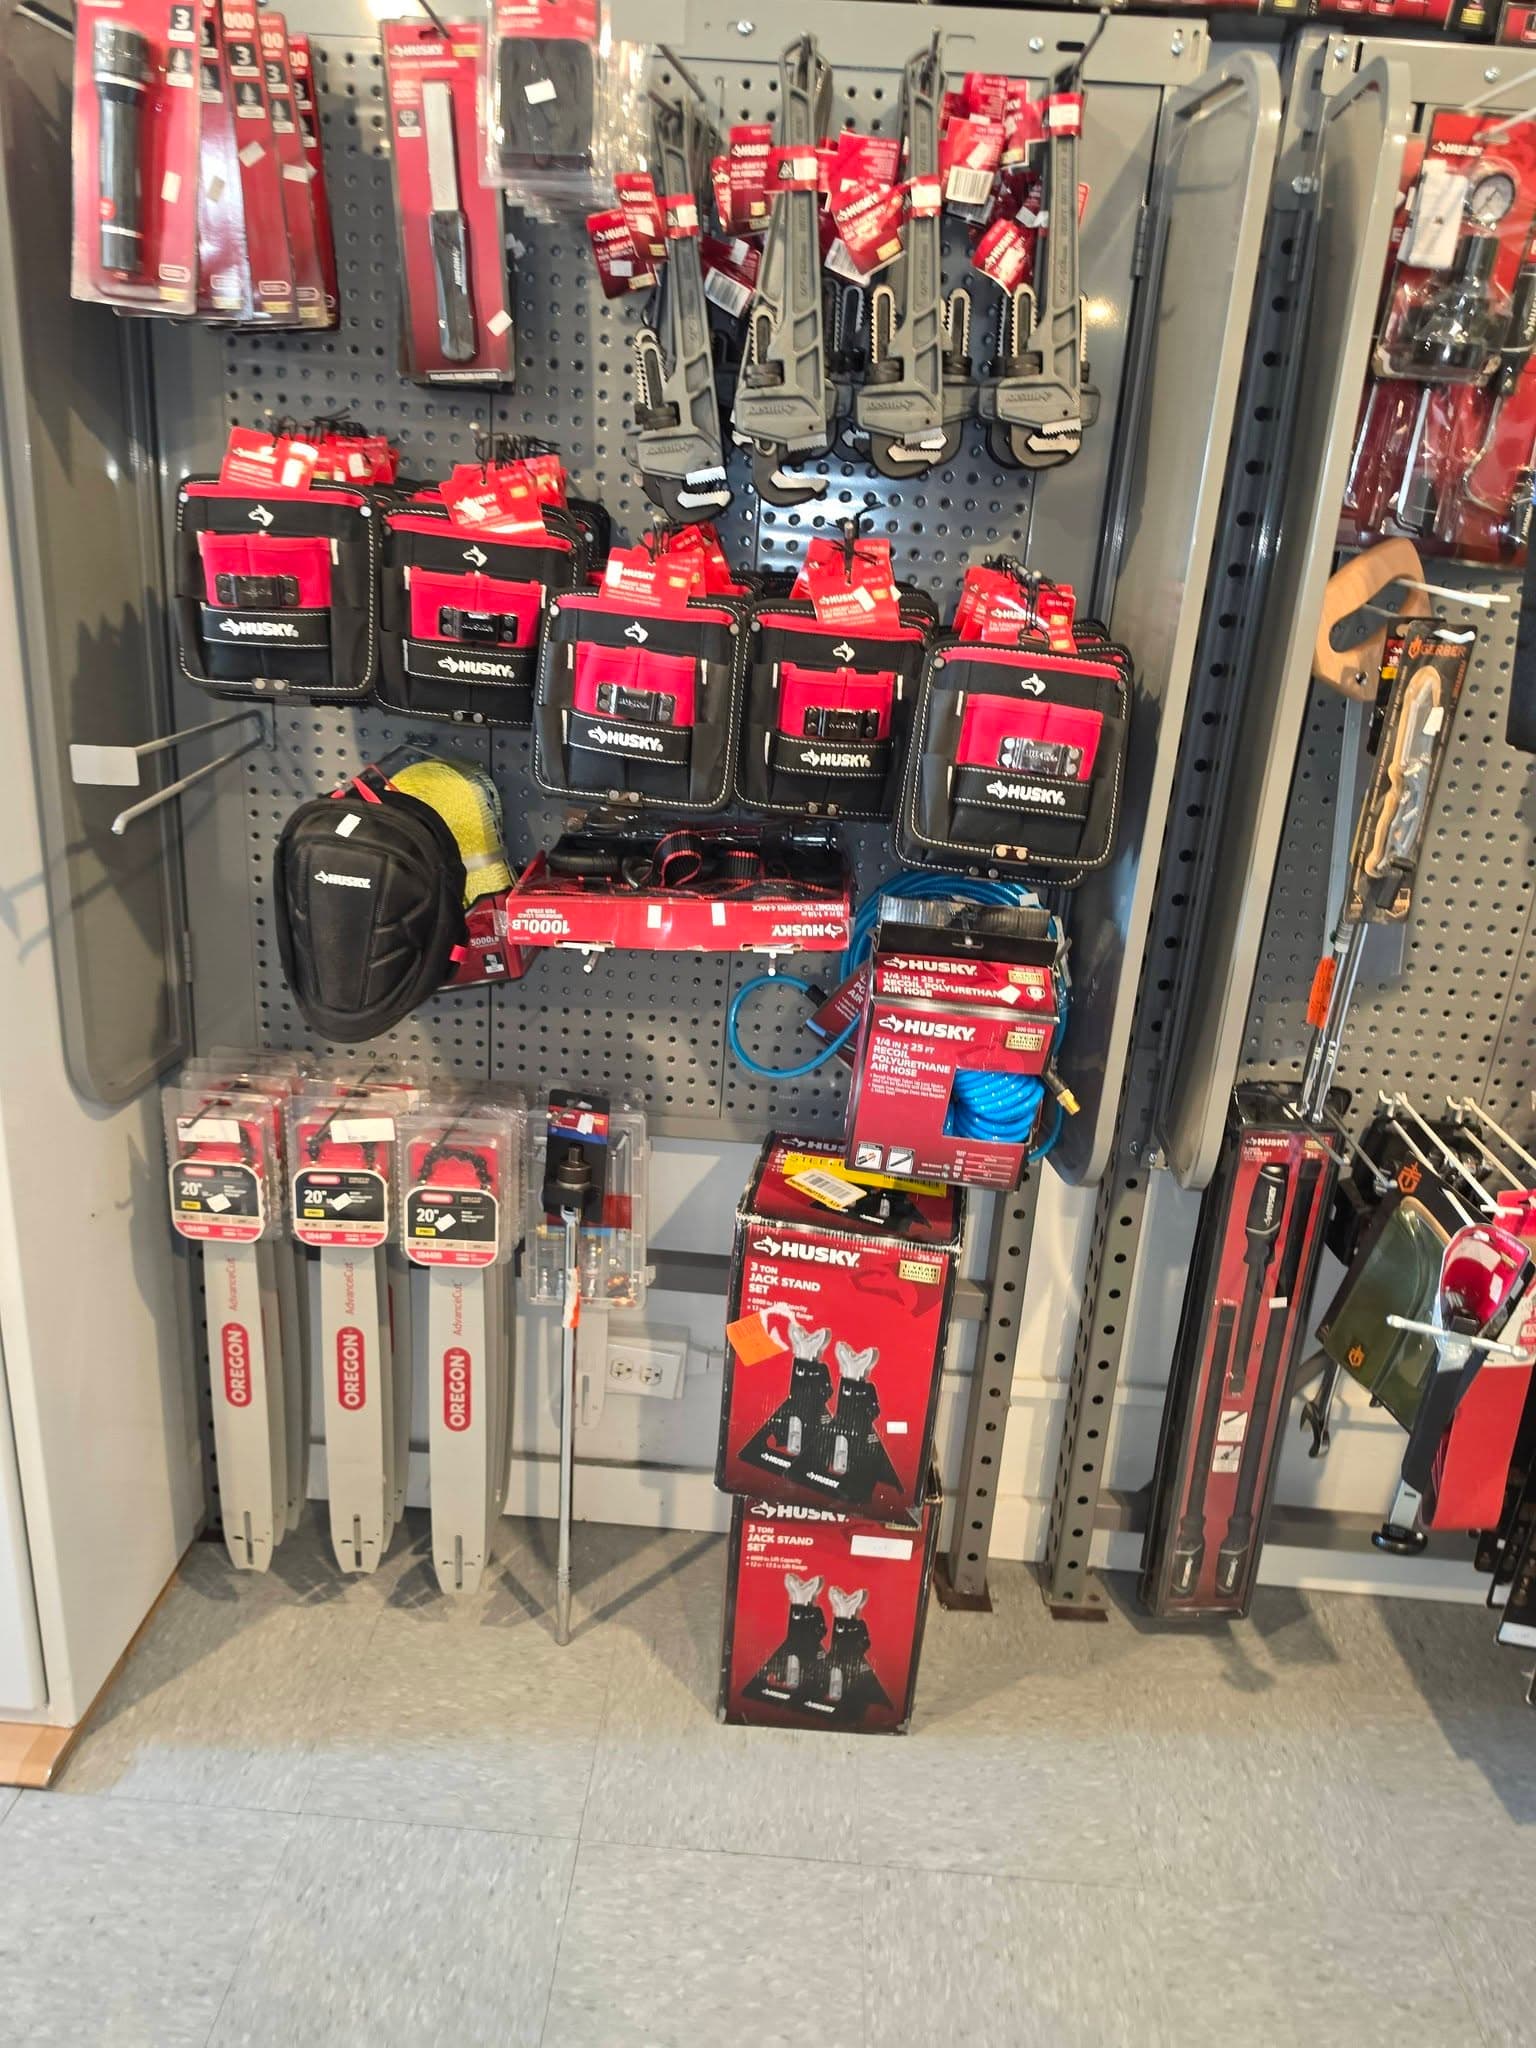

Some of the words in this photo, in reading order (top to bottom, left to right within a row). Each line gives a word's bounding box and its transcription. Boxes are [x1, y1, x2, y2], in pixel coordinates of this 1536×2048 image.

[173, 8, 192, 30] 3
[235, 46, 251, 66] 3
[265, 64, 281, 83] 3
[240, 622, 297, 637] HUSKY
[1420, 643, 1467, 657] GERBER
[458, 659, 513, 678] HUSKY
[607, 732, 662, 752] HUSKY
[820, 752, 870, 768] HUSKY
[1007, 784, 1066, 806] HUSKY
[511, 919, 571, 934] 1000LB
[772, 923, 825, 937] HUSKY
[908, 959, 976, 976] HUSKY
[882, 985, 903, 994] AIR
[905, 986, 933, 997] HOSE
[883, 978, 924, 990] RECOIL
[925, 983, 1000, 998] POLYURETHAN
[904, 1018, 976, 1041] HUSKY
[875, 1036, 891, 1046] 1/4
[892, 1040, 901, 1048] IN
[910, 1042, 923, 1051] 25
[874, 1045, 910, 1059] RECOIL
[870, 1062, 891, 1074] AIR
[893, 1065, 918, 1078] HOSE
[872, 1053, 950, 1074] POLYURETHANE
[807, 1140, 848, 1153] HUS
[1257, 1137, 1290, 1148] HUSKY
[180, 1181, 203, 1196] 20"
[303, 1189, 328, 1204] 20"
[416, 1208, 440, 1223] 20"
[781, 1240, 860, 1268] HUSKY
[750, 1261, 758, 1272] 3
[759, 1264, 778, 1275] TON
[226, 1257, 238, 1312] AdvanceCut
[344, 1262, 356, 1316] AdvanceCut
[748, 1274, 779, 1286] JACK
[781, 1277, 821, 1292] STAND
[748, 1283, 769, 1294] SET
[453, 1283, 464, 1336] AdvanceCut
[227, 1329, 247, 1404] OREGON
[342, 1333, 361, 1406] OREGON
[448, 1354, 466, 1427] OREGON
[748, 1524, 756, 1533] 3
[757, 1526, 774, 1535] TON
[746, 1543, 767, 1553] SET
[747, 1534, 775, 1544] JACK
[777, 1535, 814, 1546] STAND
